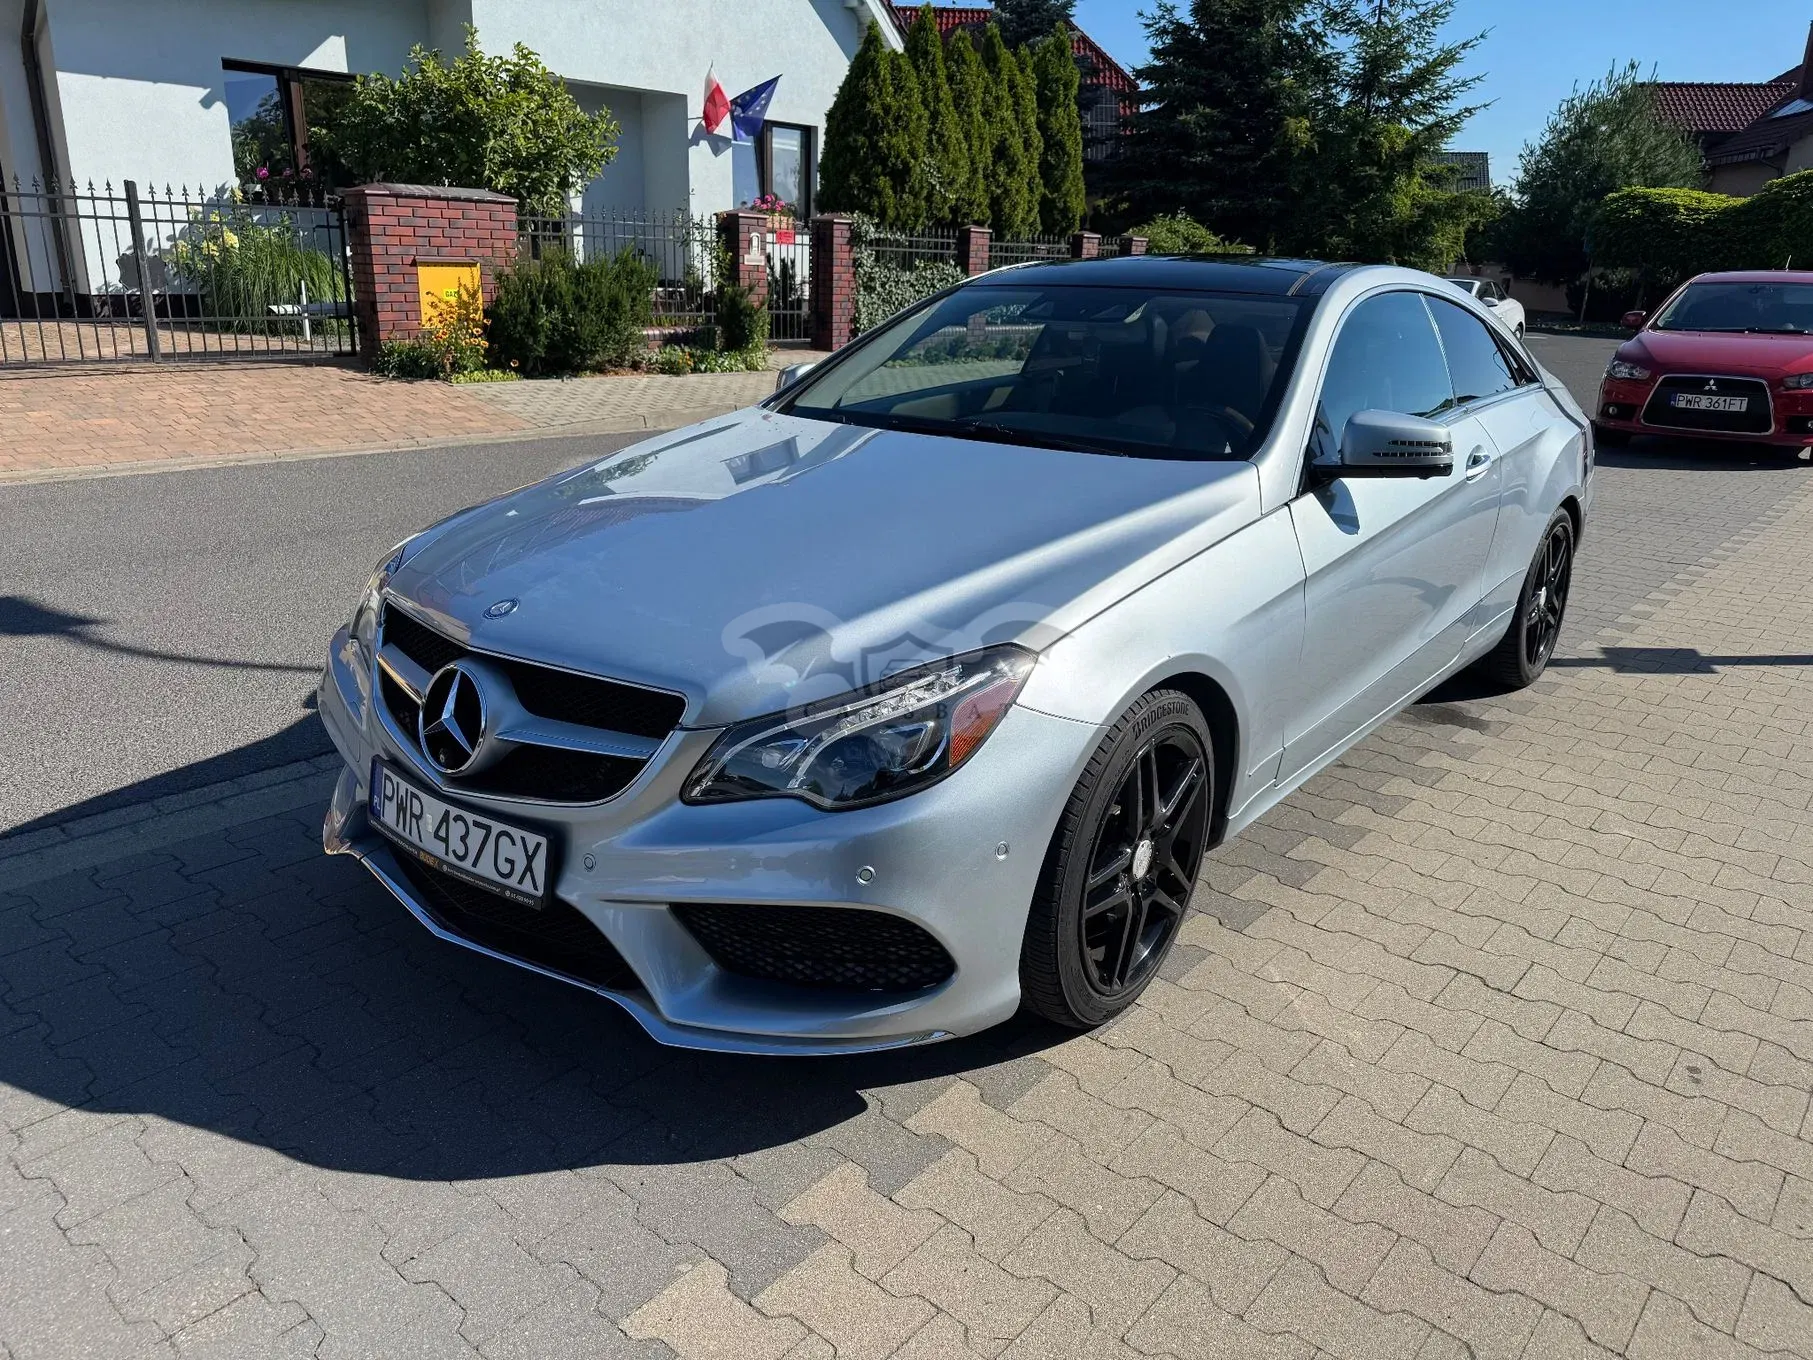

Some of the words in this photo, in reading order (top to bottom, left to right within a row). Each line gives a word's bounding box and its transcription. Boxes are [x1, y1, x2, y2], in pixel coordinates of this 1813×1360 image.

[1676, 394, 1703, 408] PWR
[1704, 396, 1747, 411] 361FT
[1131, 701, 1190, 741] BRIDGESTONE
[373, 794, 381, 811] PL
[381, 772, 424, 843] PWR
[433, 808, 543, 892] 437GX
